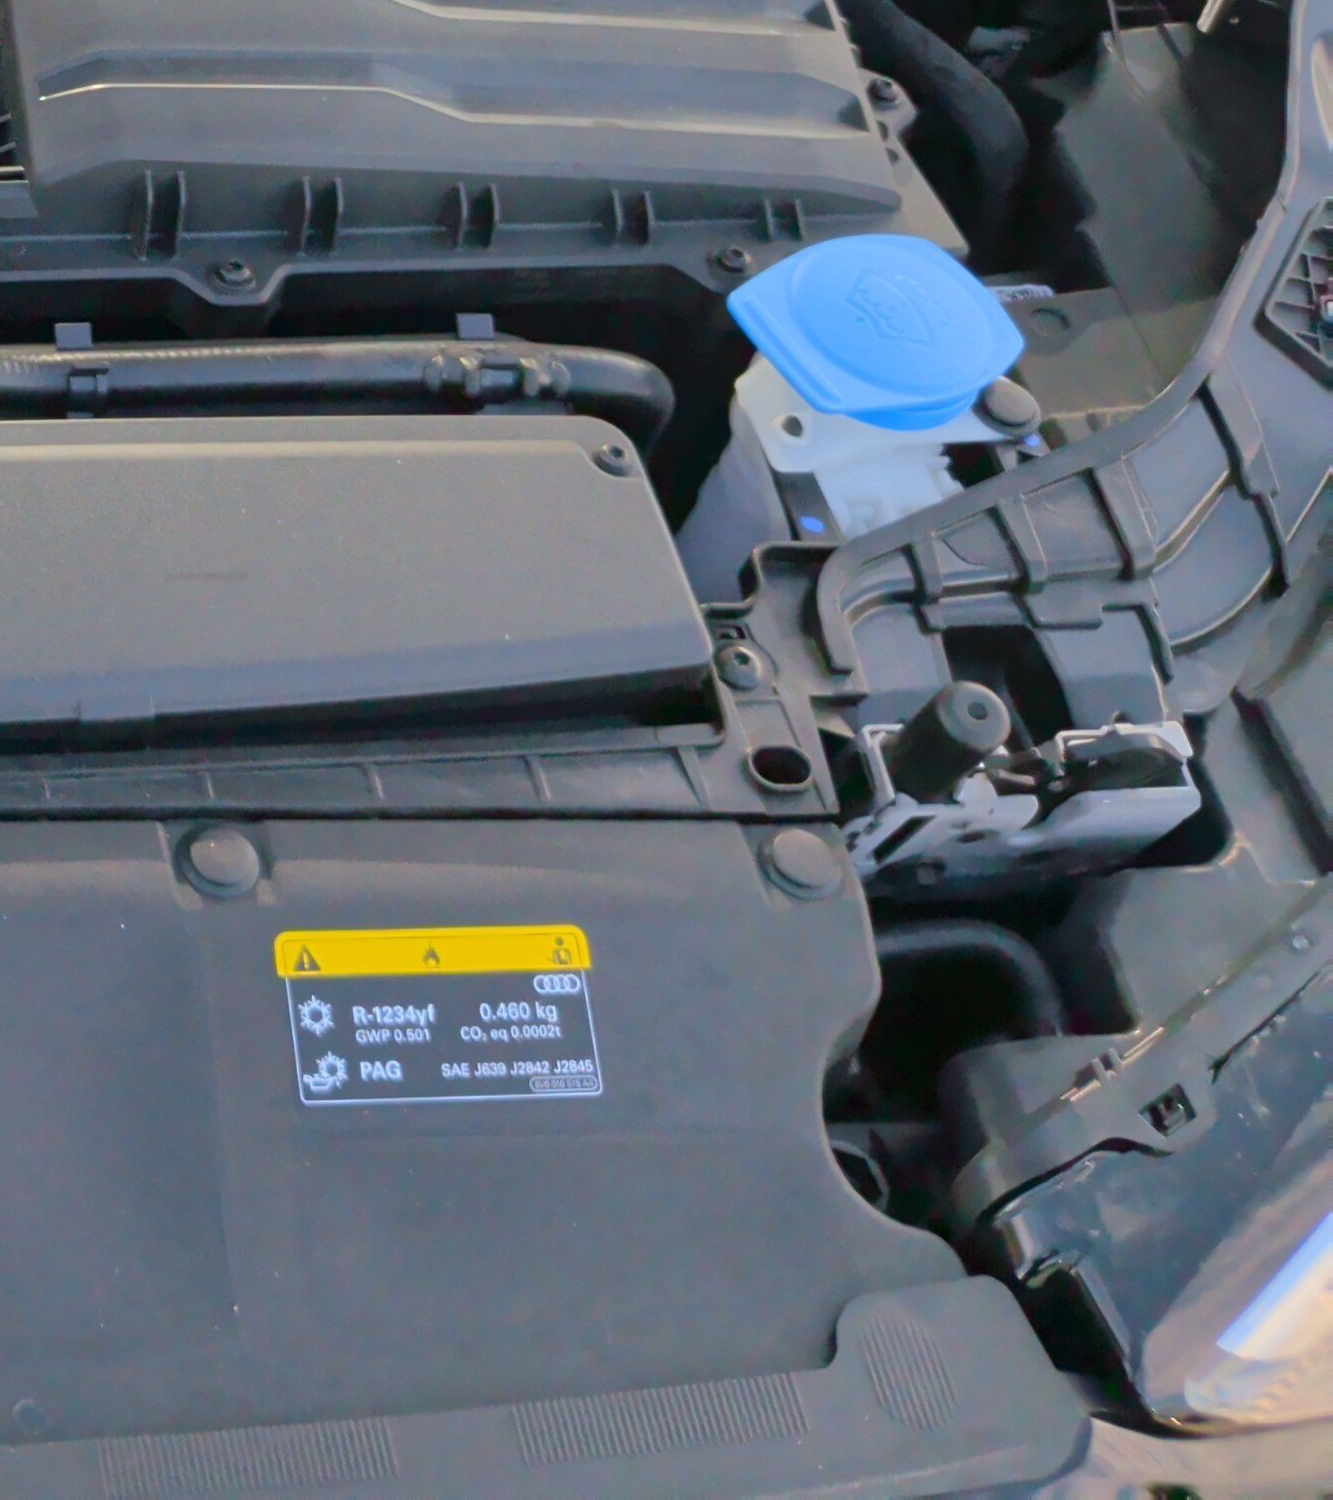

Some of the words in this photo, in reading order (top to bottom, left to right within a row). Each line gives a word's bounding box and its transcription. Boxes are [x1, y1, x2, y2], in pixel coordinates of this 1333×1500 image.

[352, 1003, 437, 1026] R-1234yf
[479, 1002, 530, 1021] 0.460
[535, 1001, 558, 1023] kg
[355, 1029, 391, 1044] GWP
[394, 1028, 431, 1043] 0.501
[490, 1028, 508, 1043] eq
[511, 1025, 563, 1039] 0.0002t
[360, 1060, 403, 1081] PAG
[441, 1063, 470, 1077] SAE
[474, 1062, 506, 1077] J639
[510, 1061, 550, 1075] J2842
